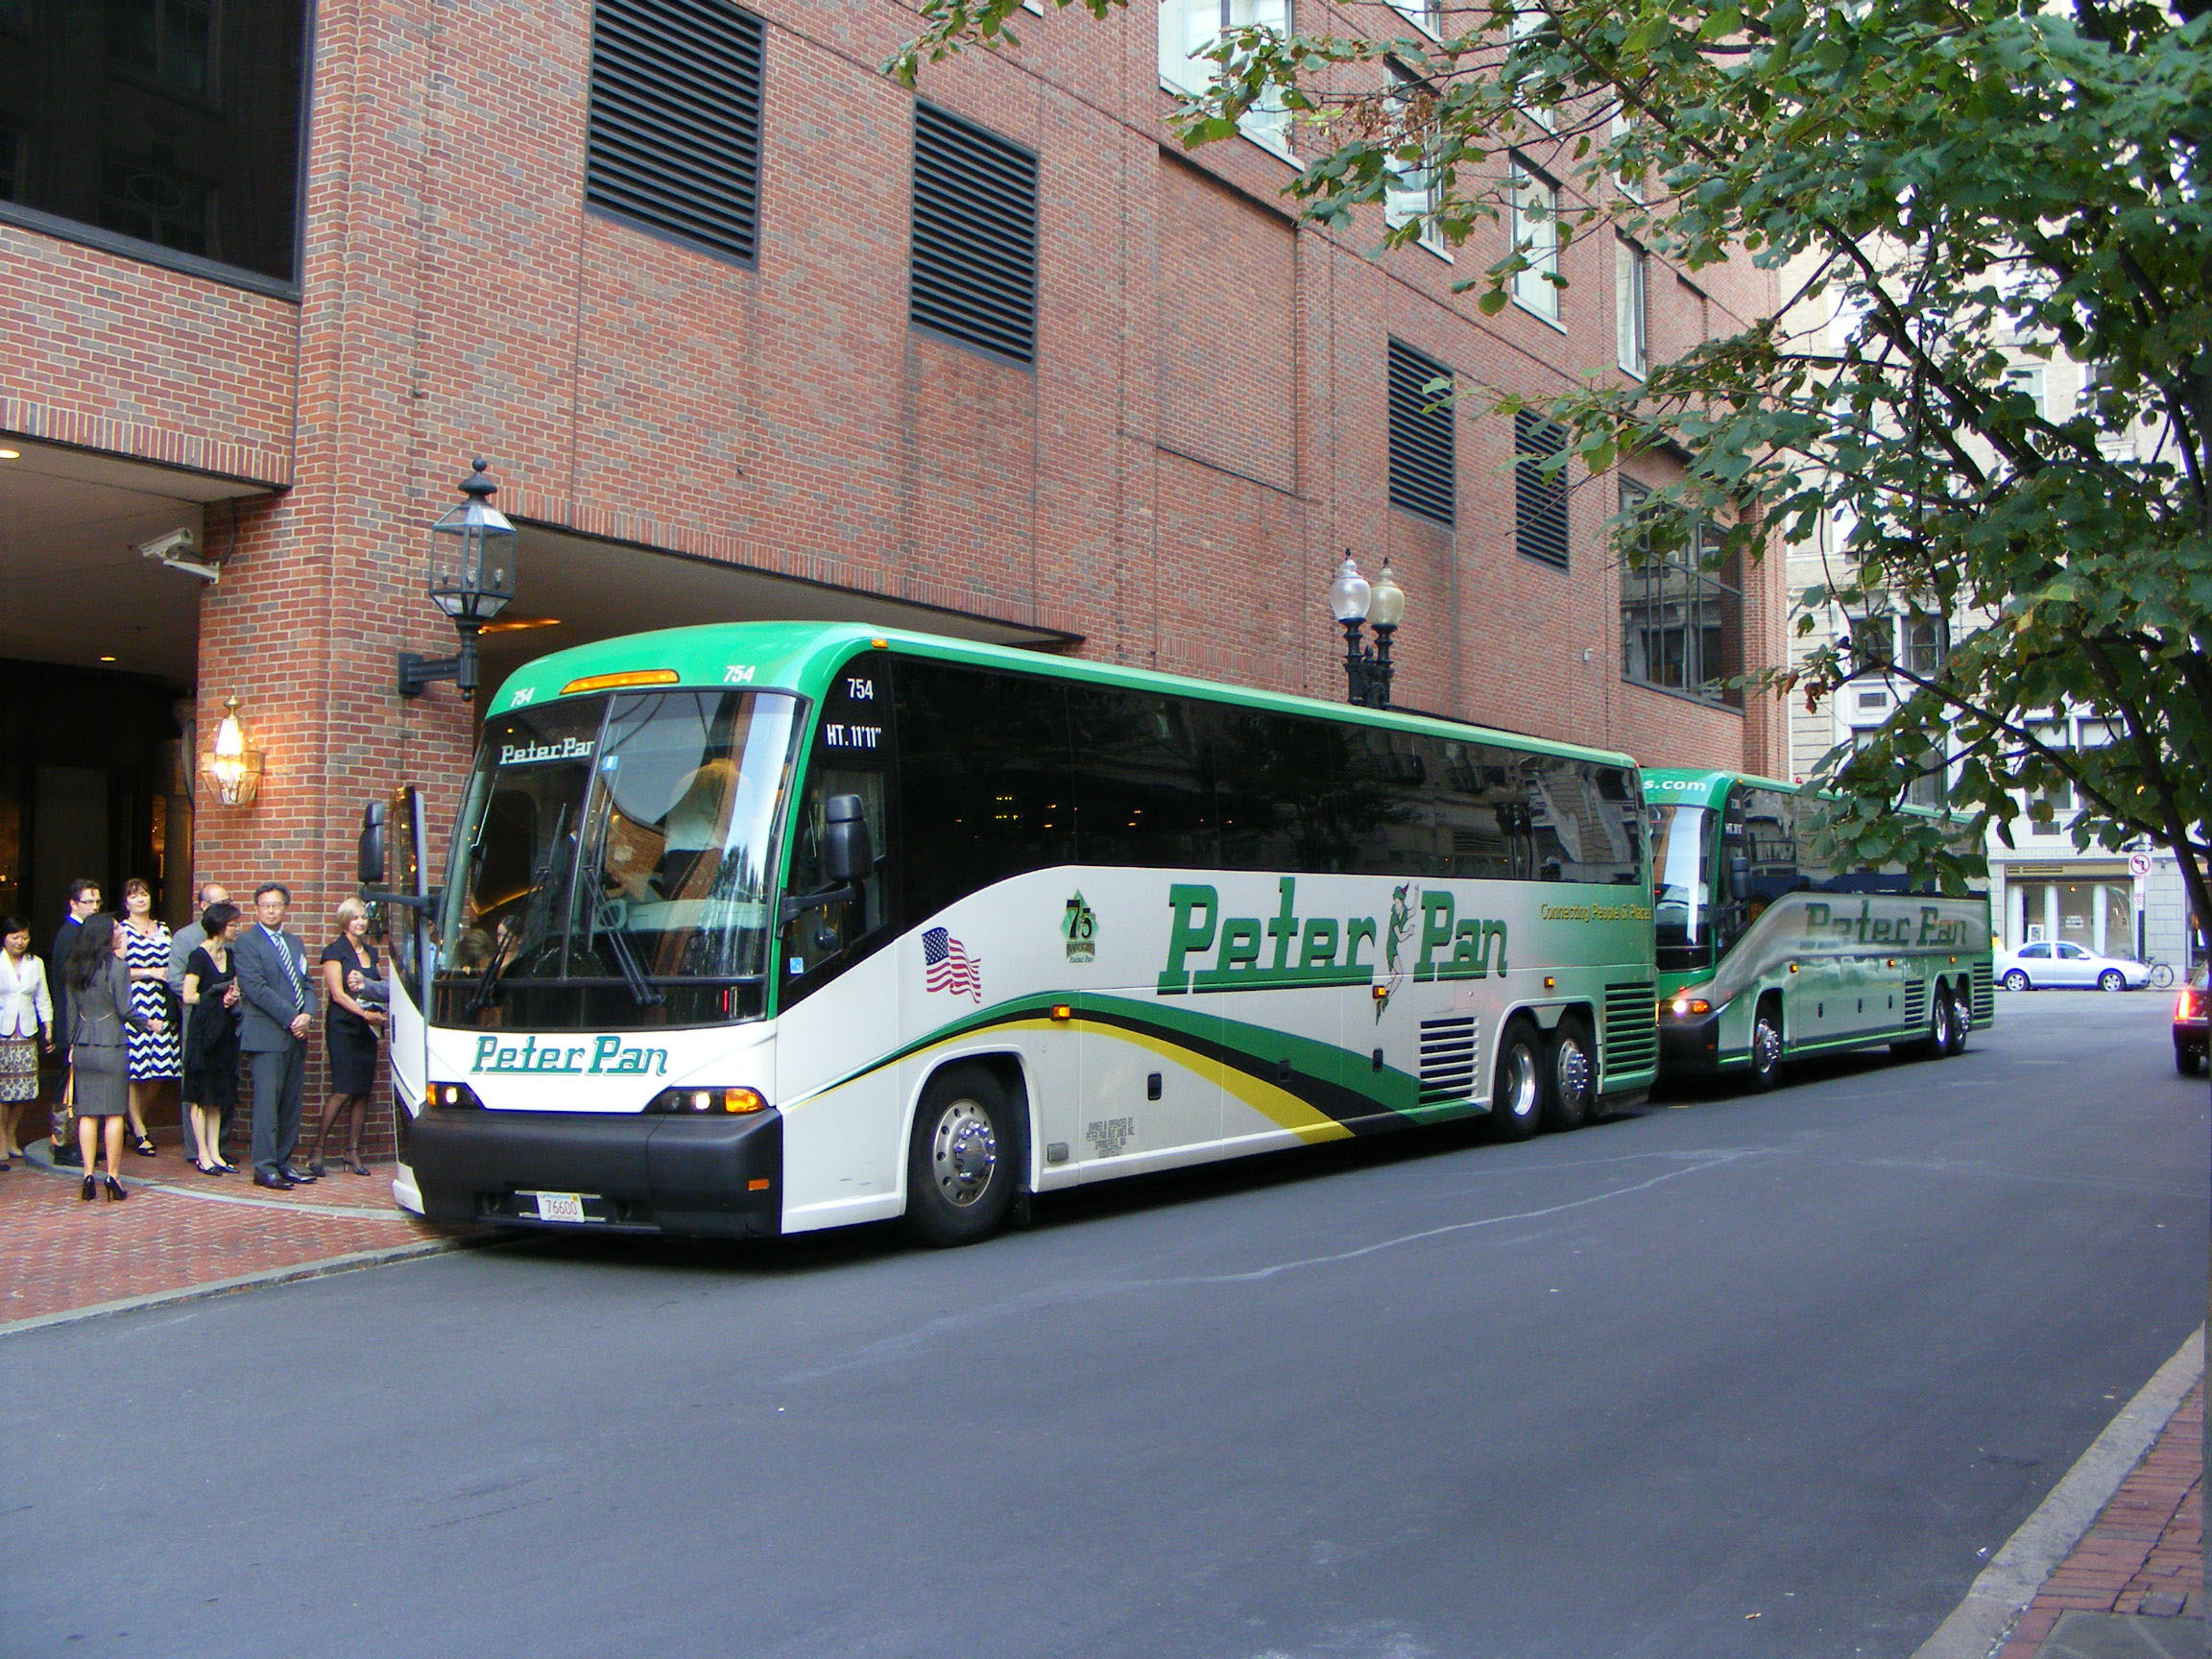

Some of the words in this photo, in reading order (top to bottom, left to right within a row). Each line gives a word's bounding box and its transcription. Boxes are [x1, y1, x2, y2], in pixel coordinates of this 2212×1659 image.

[722, 664, 757, 683] 754
[510, 686, 536, 709] 754
[846, 678, 874, 700] 754
[826, 724, 849, 746] HT.
[499, 740, 563, 765] Peter
[1157, 876, 1378, 996] Peter
[1412, 890, 1508, 983] Pan
[1799, 900, 1911, 950] Peter
[1915, 906, 1967, 947] Pan
[469, 1035, 586, 1075] Peter
[585, 1035, 669, 1077] Pan
[545, 1199, 578, 1215] 76600
